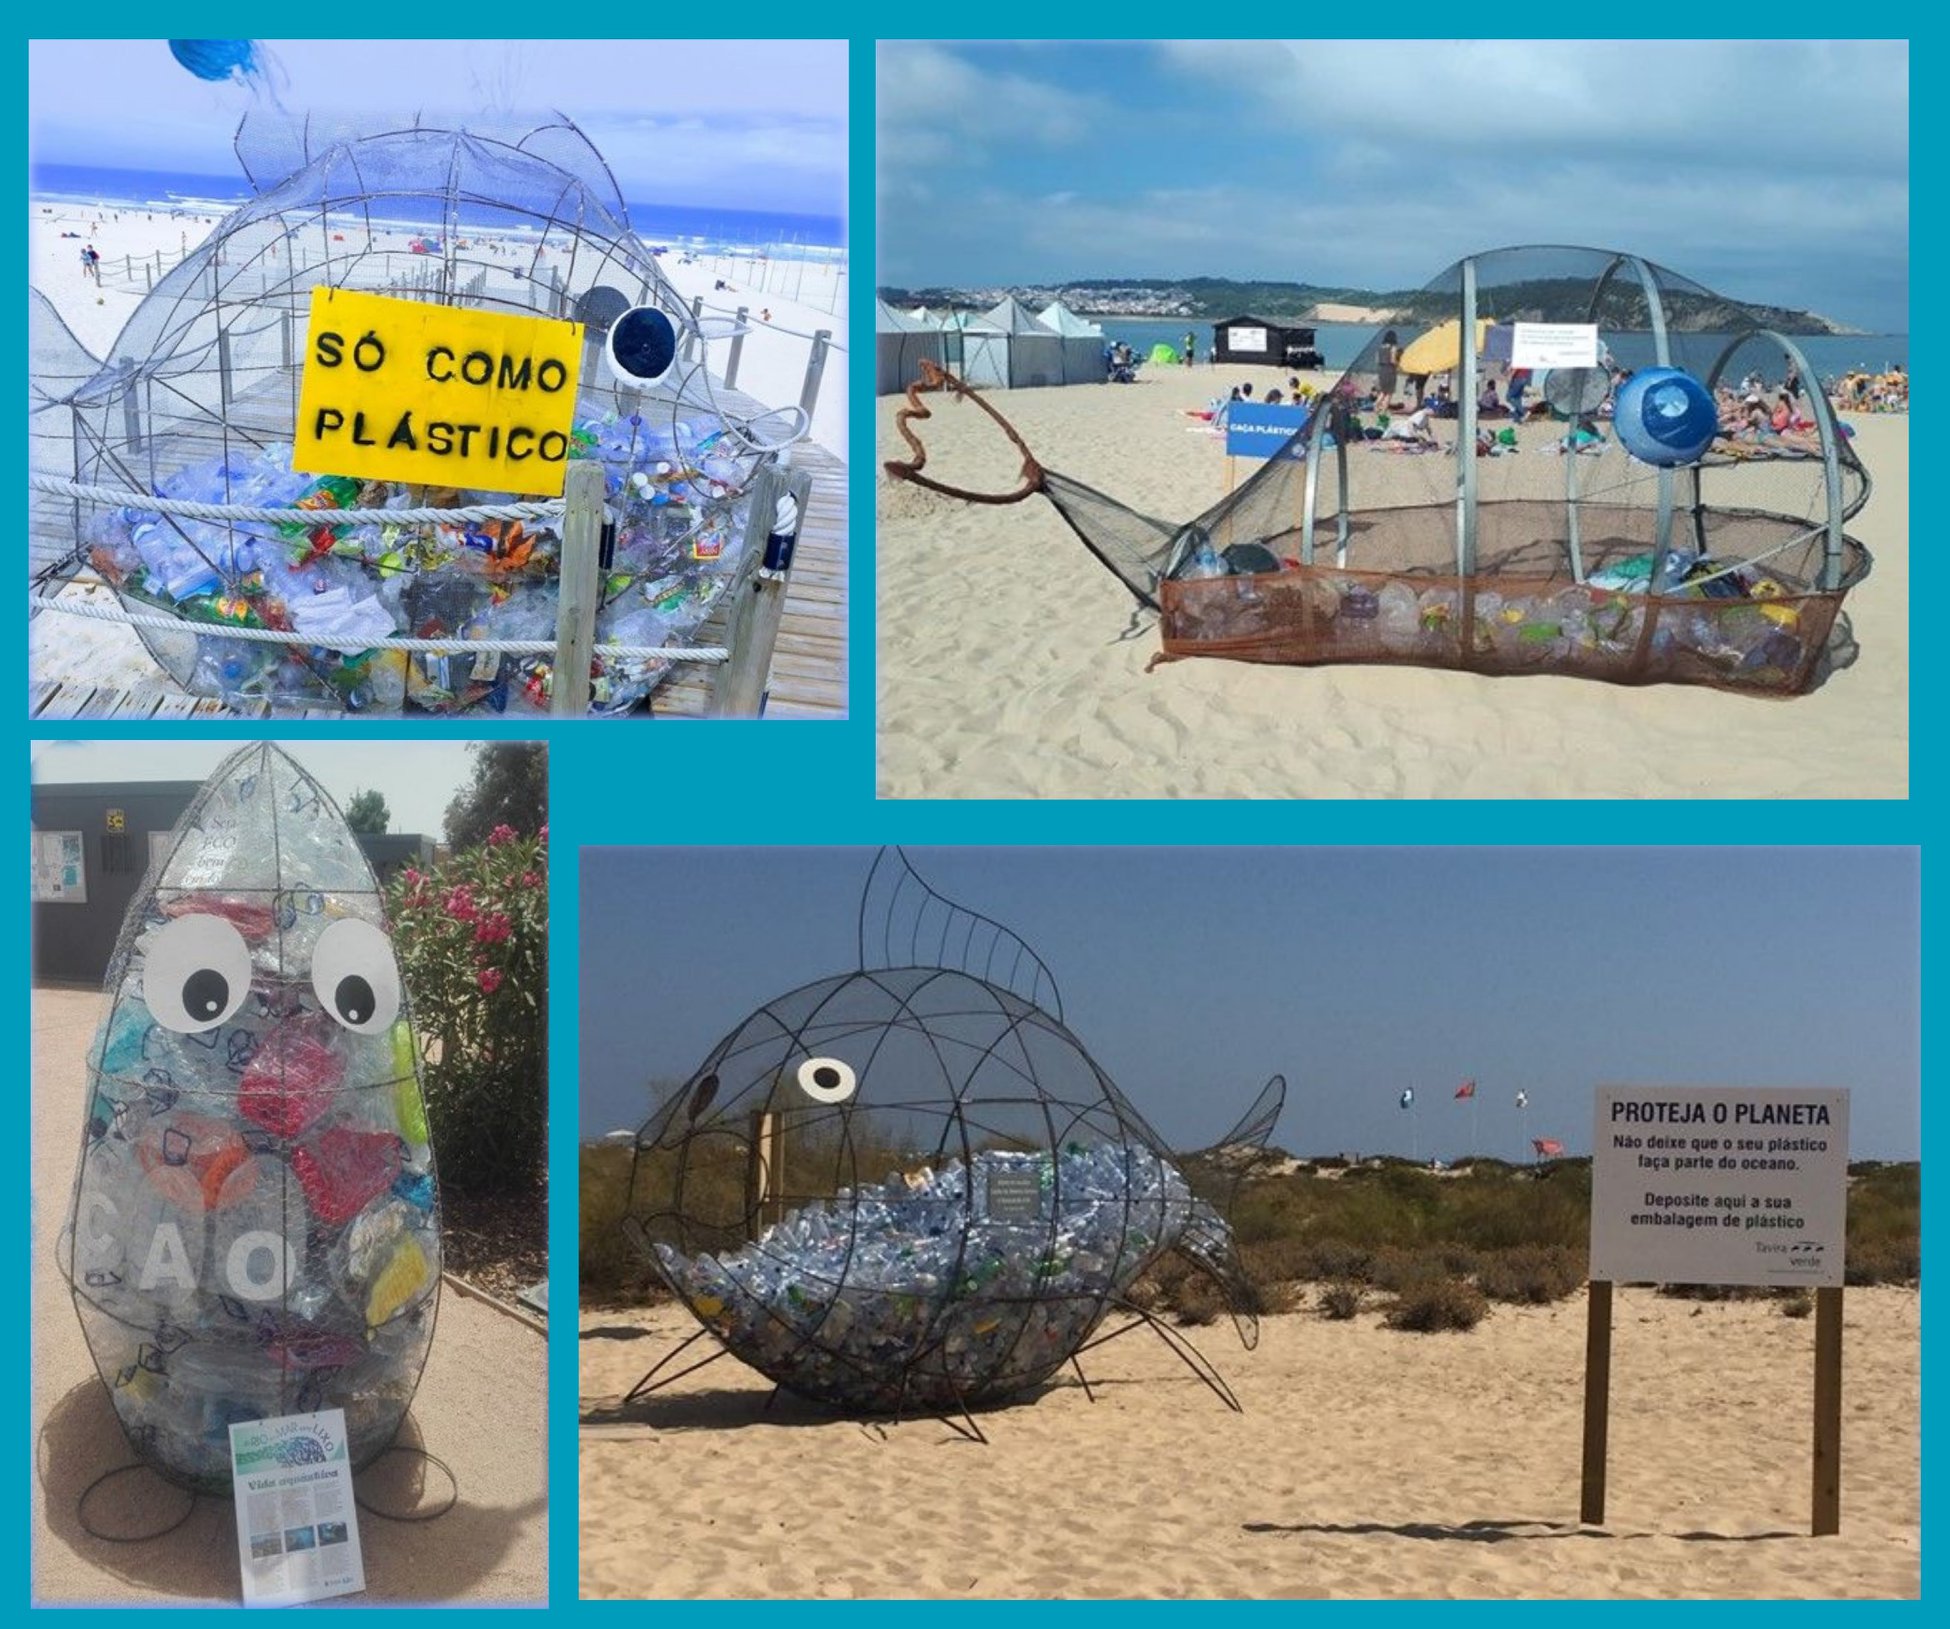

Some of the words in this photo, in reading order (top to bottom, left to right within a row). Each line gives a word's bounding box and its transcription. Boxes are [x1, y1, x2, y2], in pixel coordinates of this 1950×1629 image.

[316, 331, 385, 372] SÓ
[426, 346, 567, 393] COMO
[315, 409, 567, 461] PLÁSTICO
[1611, 1102, 1706, 1124] PROTEJA
[1713, 1103, 1728, 1124] O
[1735, 1104, 1830, 1126] PLANETA
[1613, 1134, 1642, 1149] Não
[1647, 1135, 1686, 1149] deixe
[1691, 1138, 1718, 1152] que
[1723, 1139, 1732, 1149] o
[1737, 1138, 1763, 1150] seu
[1768, 1137, 1828, 1152] plástico
[1638, 1154, 1670, 1171] faça
[1675, 1155, 1713, 1170] parte
[1718, 1157, 1737, 1169] do
[1741, 1158, 1799, 1170] oceano.
[1644, 1193, 1709, 1209] Deposite
[1714, 1195, 1746, 1210] aqui
[1751, 1198, 1760, 1208] a
[1765, 1197, 1792, 1209] sua
[1630, 1213, 1718, 1229] embalagem
[1723, 1215, 1740, 1228] de
[1746, 1215, 1805, 1230] plástico
[1789, 1256, 1821, 1267] verde
